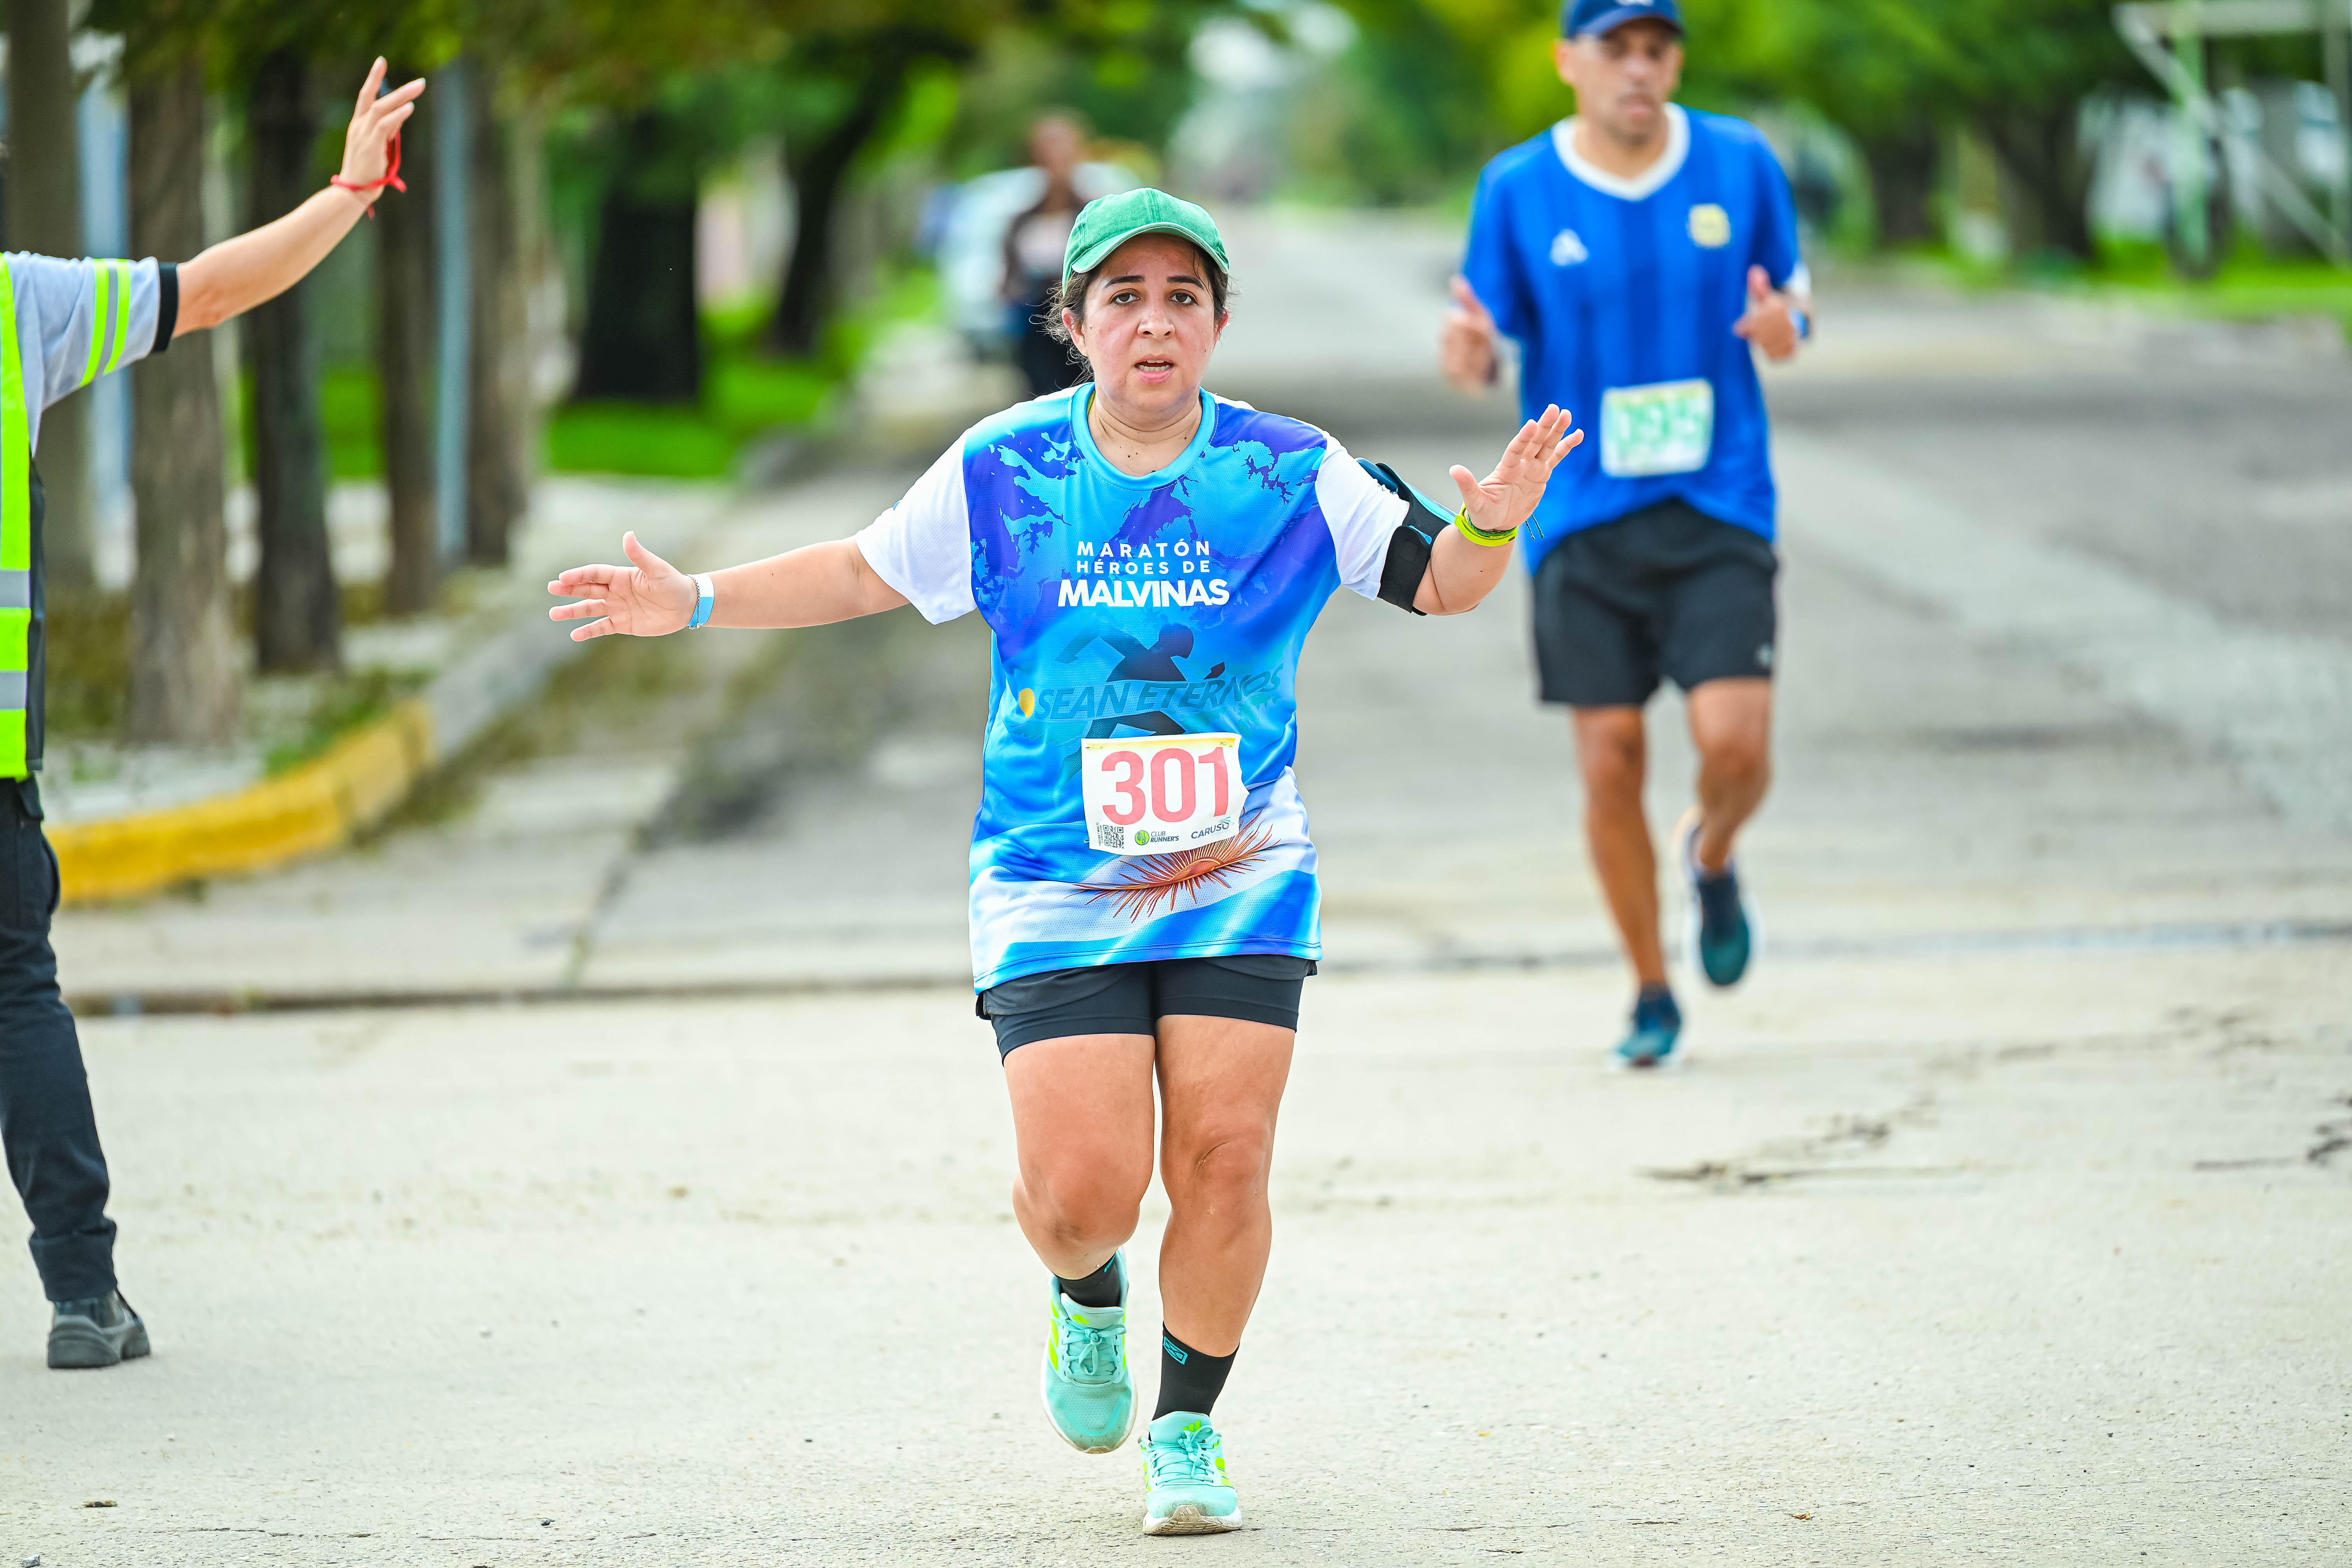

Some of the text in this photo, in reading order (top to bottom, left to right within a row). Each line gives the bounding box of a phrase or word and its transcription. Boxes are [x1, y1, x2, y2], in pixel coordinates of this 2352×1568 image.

[1077, 539, 1209, 558] MARATÓN
[1076, 559, 1210, 575] HÉROES DE
[1058, 578, 1230, 607] MALVINAS
[1034, 665, 1283, 719] SEAN ETERNOS
[1102, 747, 1228, 825] 301
[1191, 821, 1229, 838] CARUSO
